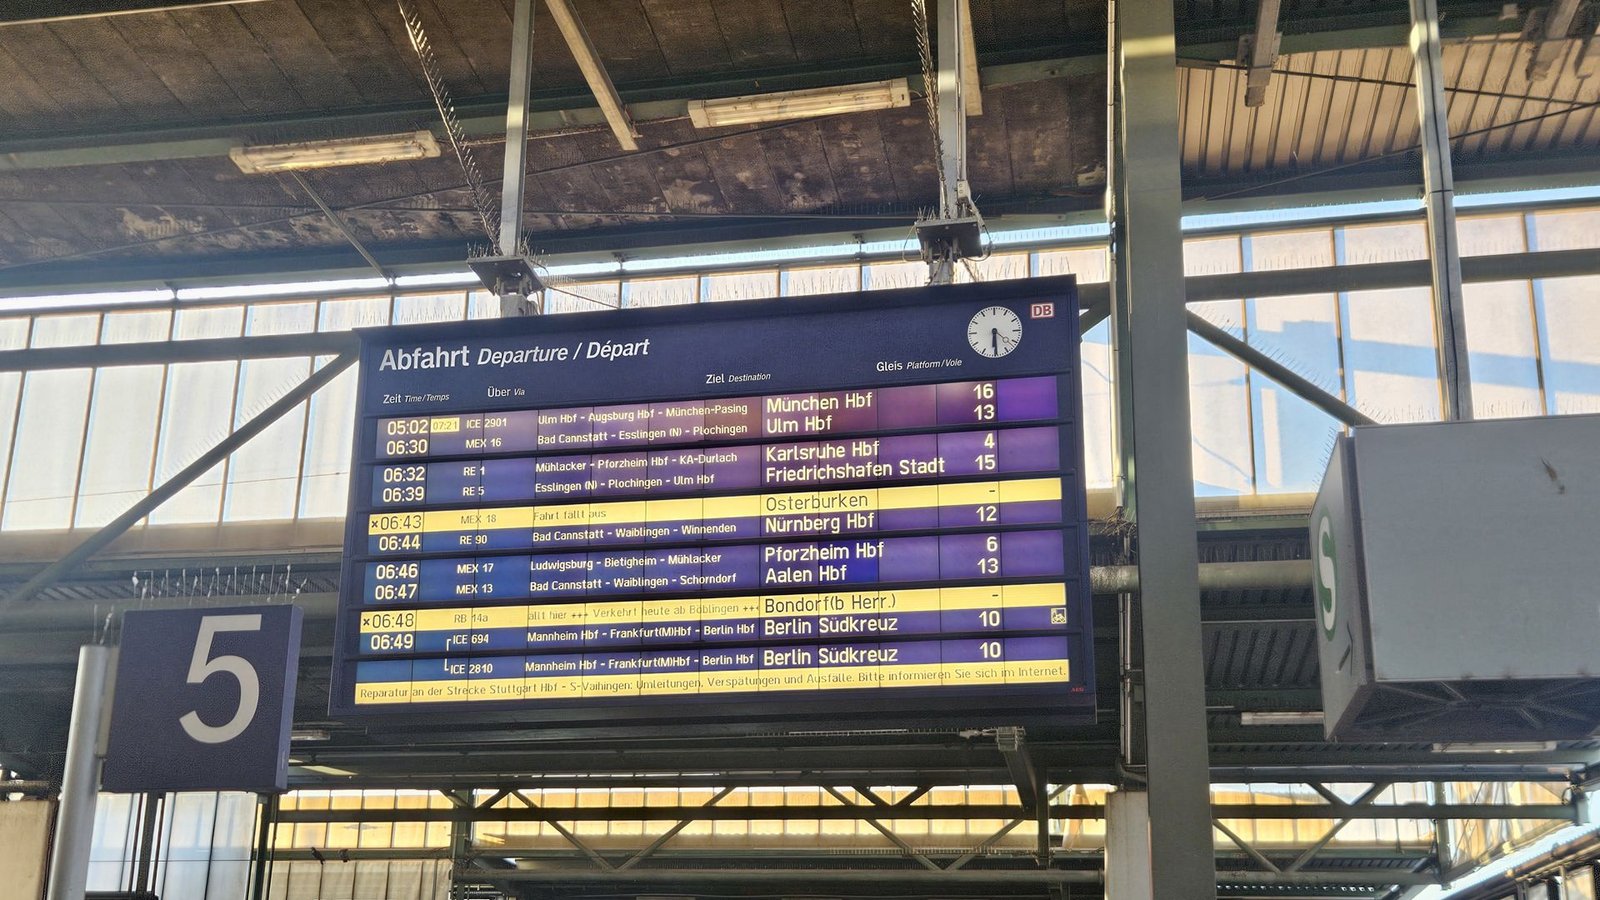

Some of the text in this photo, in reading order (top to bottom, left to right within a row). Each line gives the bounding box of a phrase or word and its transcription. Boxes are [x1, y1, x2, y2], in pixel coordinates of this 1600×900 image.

[1032, 304, 1052, 317] DB
[379, 338, 650, 371] Abfahrt Departure / Départ
[876, 361, 903, 371] Gleis
[487, 386, 525, 398] Über Via
[706, 372, 771, 385] Ziel Destination
[383, 394, 401, 404] Zeit
[387, 383, 994, 436] 05:02 07:21 ICE 2901 Ulm Hbf Augsburg Hbf München-Pasing München Hbf 16
[386, 404, 995, 455] 06:30 MEX 16 Bad Cannstatt Esslingen (N) Plochingen Ulm Hbf 13
[384, 433, 995, 483] 06:32 RE 1 Mühlacker Pforzheim Hbf KA-Durlach Karlsruhe Hbf 4
[383, 454, 996, 503] 06:39 RE 5 Esslingen (N) Plochingen Ulm Hbf Friedrichshafen Stadt 15
[461, 515, 481, 524] MEX
[487, 514, 497, 523] 18
[534, 511, 559, 521] Fahrt
[766, 494, 869, 511] Osterburken
[379, 505, 997, 551] 06:44 RE 90 Bad Cannstatt Waiblingen Winnenden Nürnberg Hbf 12
[376, 536, 998, 579] 06:46 MEX 17 Ludwigsburg Bietigheim Mühlacker Pforzheim Hbf 6
[375, 558, 999, 600] 06:47 MEX 13 Bad Cannstatt Waiblingen Schorndorf Aalen Hbf 13
[454, 614, 467, 623] RB
[471, 614, 489, 623] 14a
[549, 610, 567, 620] hier
[593, 607, 638, 618] Verkehrt
[642, 606, 670, 617] heute
[674, 605, 686, 615] ab
[764, 594, 844, 613] Bondorf(b
[852, 593, 897, 610] Herr.)
[371, 610, 1001, 650] 06:49 ICE 694 Mannheim Hbf Frankfurt(M)Hbf Berlin Hbf Berlin Südkreuz 10
[450, 641, 1001, 675] ICE 2810 Mannheim Hbf Frankfurt(M)Hbf Berlin Hbf Berlin Südkreuz 10
[179, 614, 262, 744] 5
[360, 688, 409, 700] Reparatur
[412, 687, 424, 697] an
[427, 687, 443, 696] der
[447, 685, 486, 696] Strecke
[489, 683, 537, 695] Stuttgart
[540, 682, 558, 693] Hbf
[570, 682, 633, 694] S-Vaihingen:
[784, 674, 803, 685] und
[858, 672, 885, 682] Bitte
[888, 670, 951, 681] informieren
[955, 669, 971, 679] Sie
[975, 668, 998, 678] sich
[1001, 668, 1015, 677] im
[1018, 666, 1066, 677] Internet.
